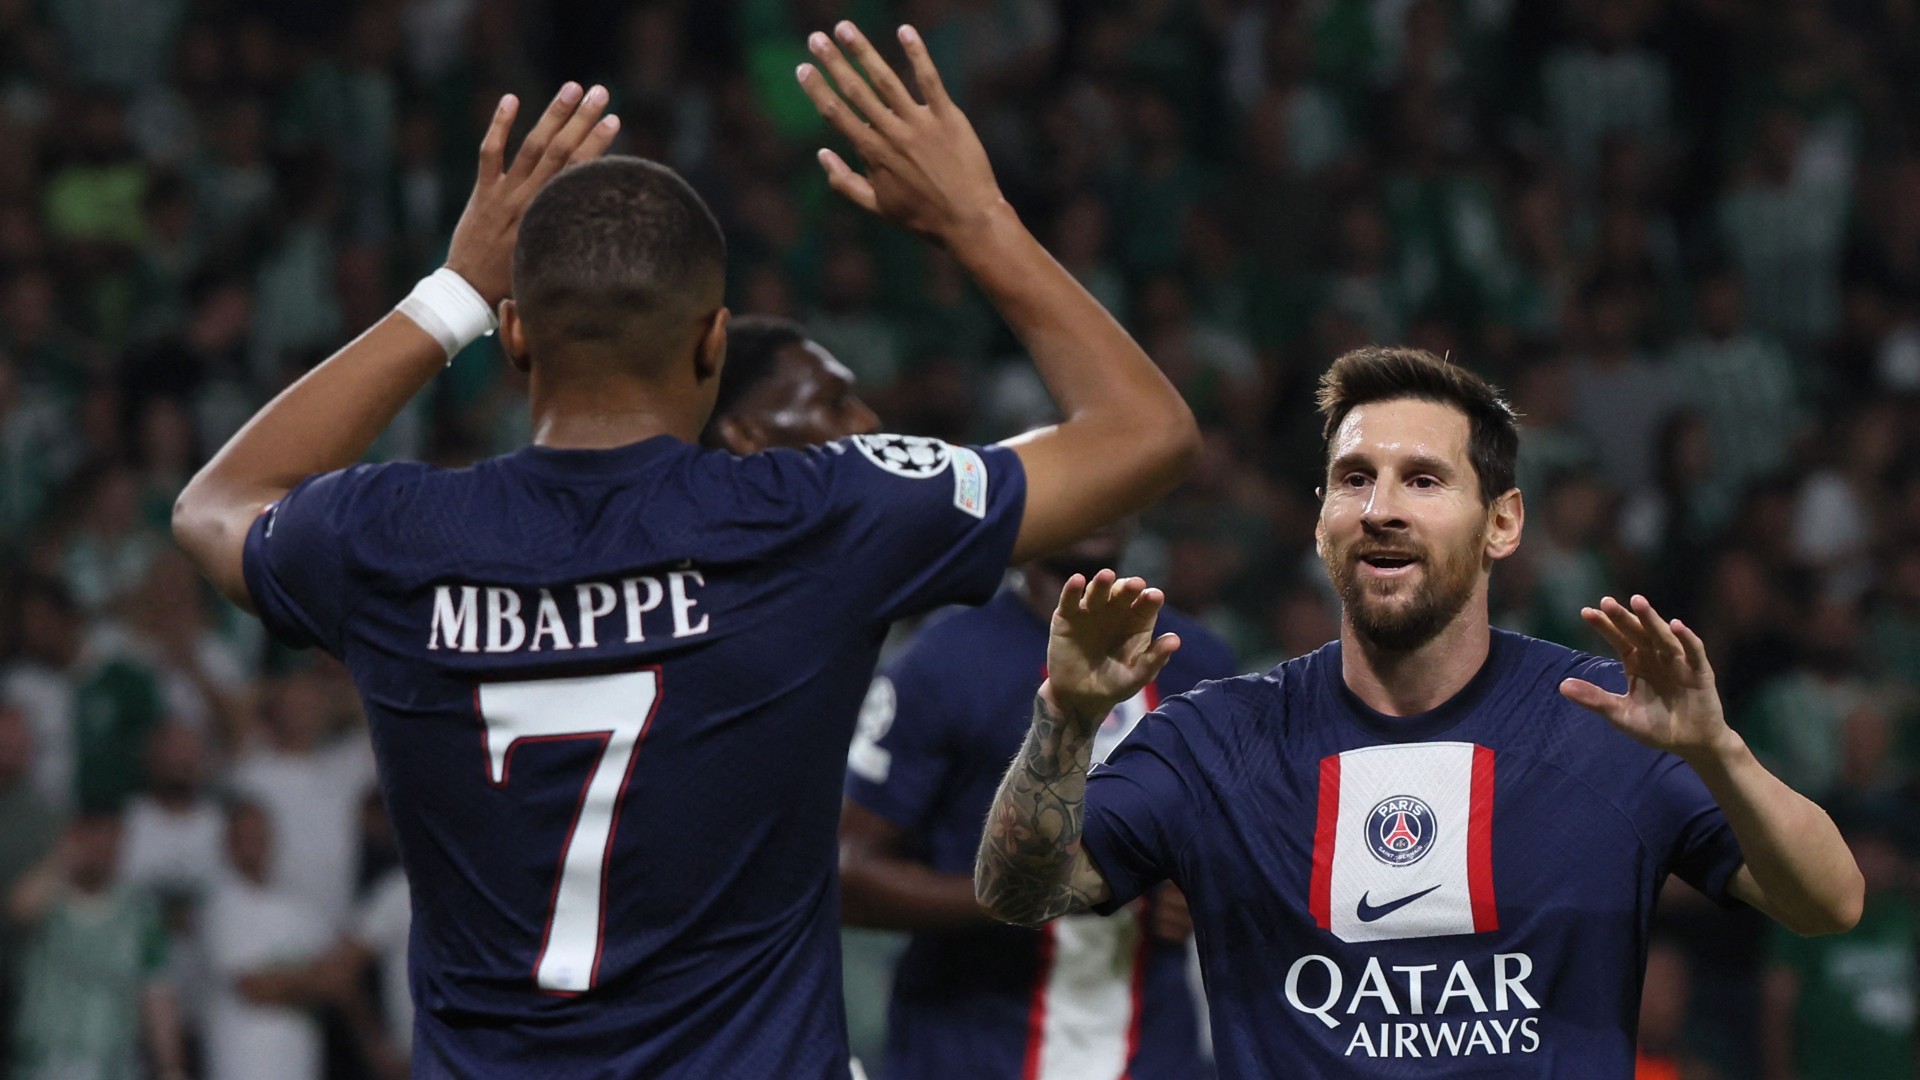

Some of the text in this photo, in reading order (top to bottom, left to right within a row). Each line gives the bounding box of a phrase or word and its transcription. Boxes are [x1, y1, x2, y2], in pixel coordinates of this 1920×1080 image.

[427, 558, 709, 652] MBAPPÉ
[473, 664, 663, 997] 7
[1378, 800, 1423, 817] PARIS
[1284, 952, 1541, 1029] QATAR
[1344, 1017, 1540, 1058] AIRWAYS
